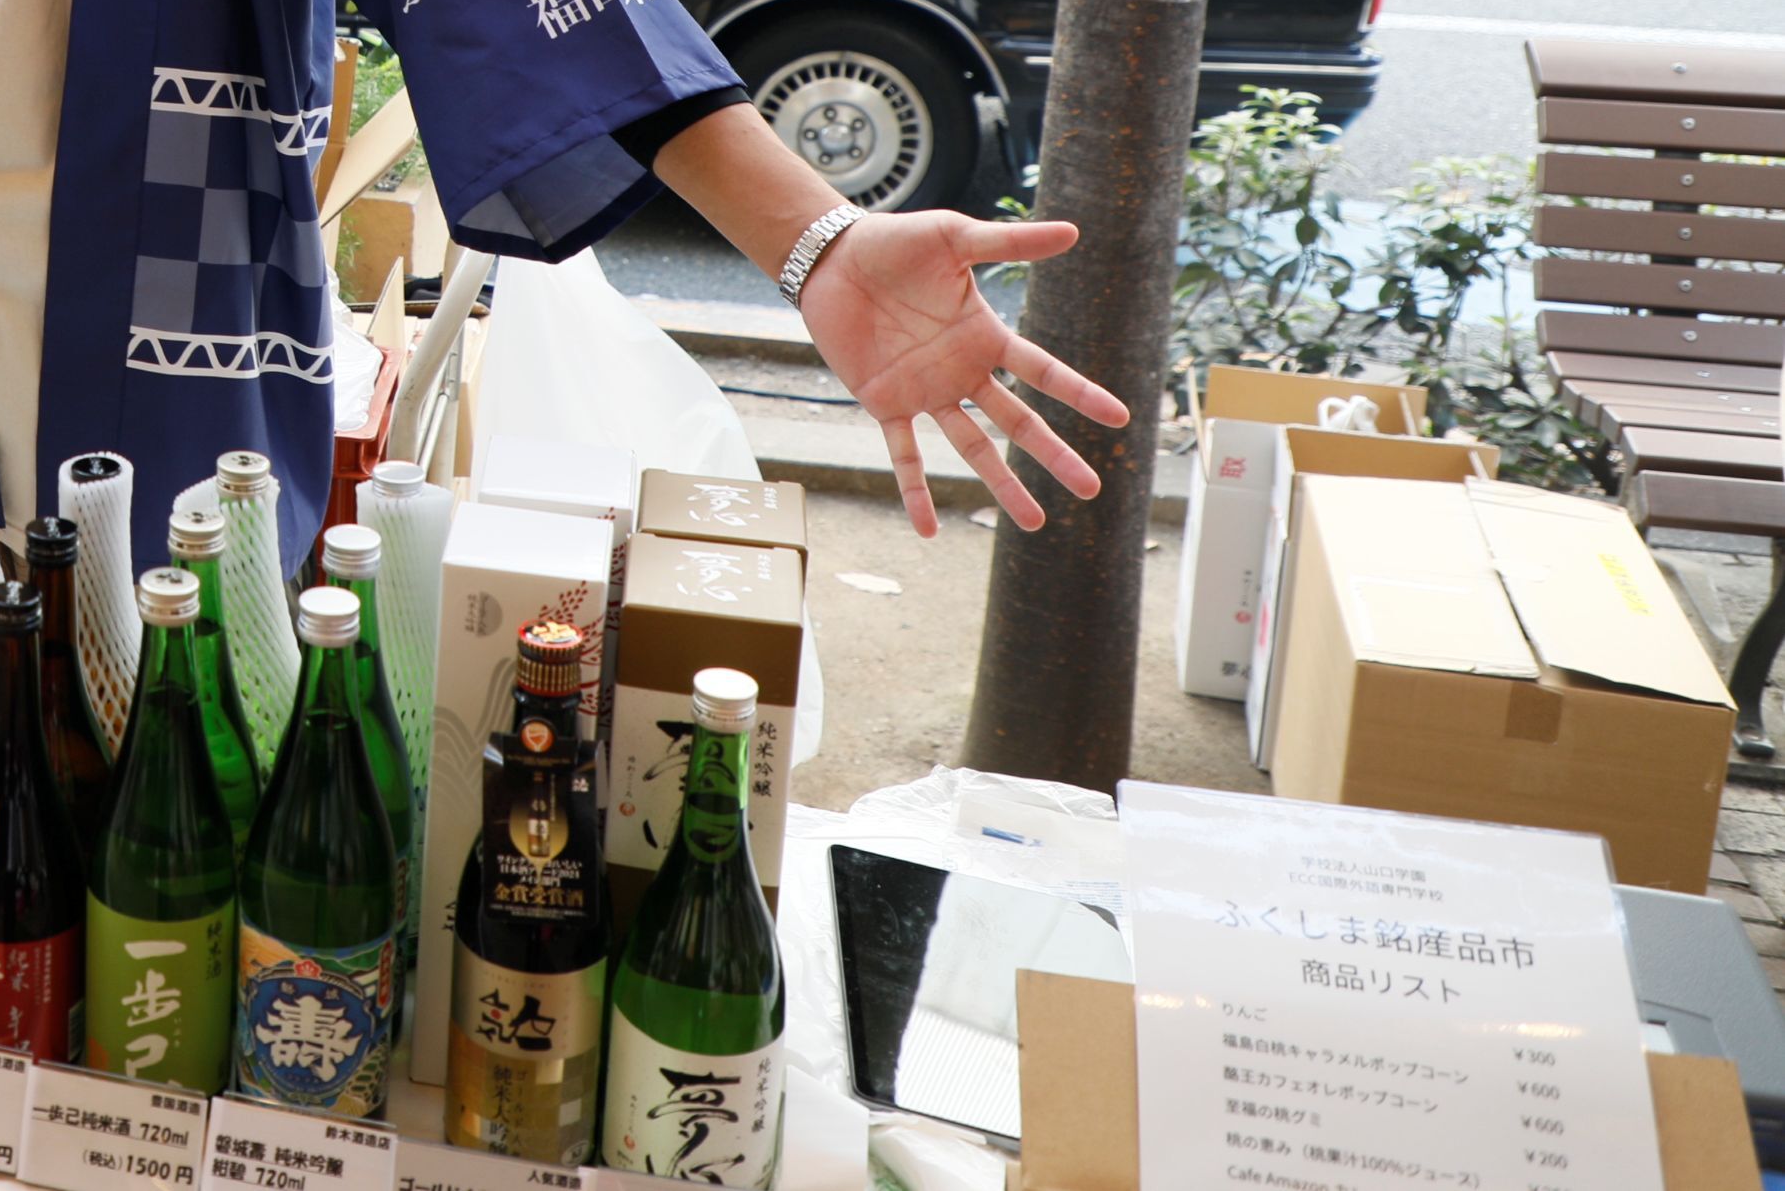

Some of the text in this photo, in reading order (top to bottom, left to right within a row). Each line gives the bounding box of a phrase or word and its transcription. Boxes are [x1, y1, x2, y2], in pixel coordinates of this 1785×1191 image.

[753, 722, 777, 798] 純米吟醸
[1301, 855, 1426, 883] 学校法人山口学園
[494, 883, 584, 907] 金賞受賞酒
[1289, 872, 1443, 902] ECC国際外語専門学校
[1216, 899, 1535, 970] ふくしま銘産品市
[1301, 959, 1461, 1004] 商品リスト
[1222, 1001, 1556, 1068] りんご ¥300
[1222, 1032, 1561, 1101] 福島白桃キャラメルポップコーン ¥600
[1222, 1066, 1565, 1136] 酪王カフェオレポップコーン ¥600
[32, 1103, 189, 1148] 一歩己純米酒 720ml
[324, 1125, 391, 1151] 鈴木酒造店
[1225, 1097, 1569, 1171] 至福の桃グミ ¥200
[175, 1166, 194, 1186] 円
[212, 1158, 305, 1191] 紺碧 720ml
[275, 1146, 344, 1178] 純米吟醸
[1227, 1164, 1263, 1185] Cafe
[527, 1168, 582, 1190] 人気酒造
